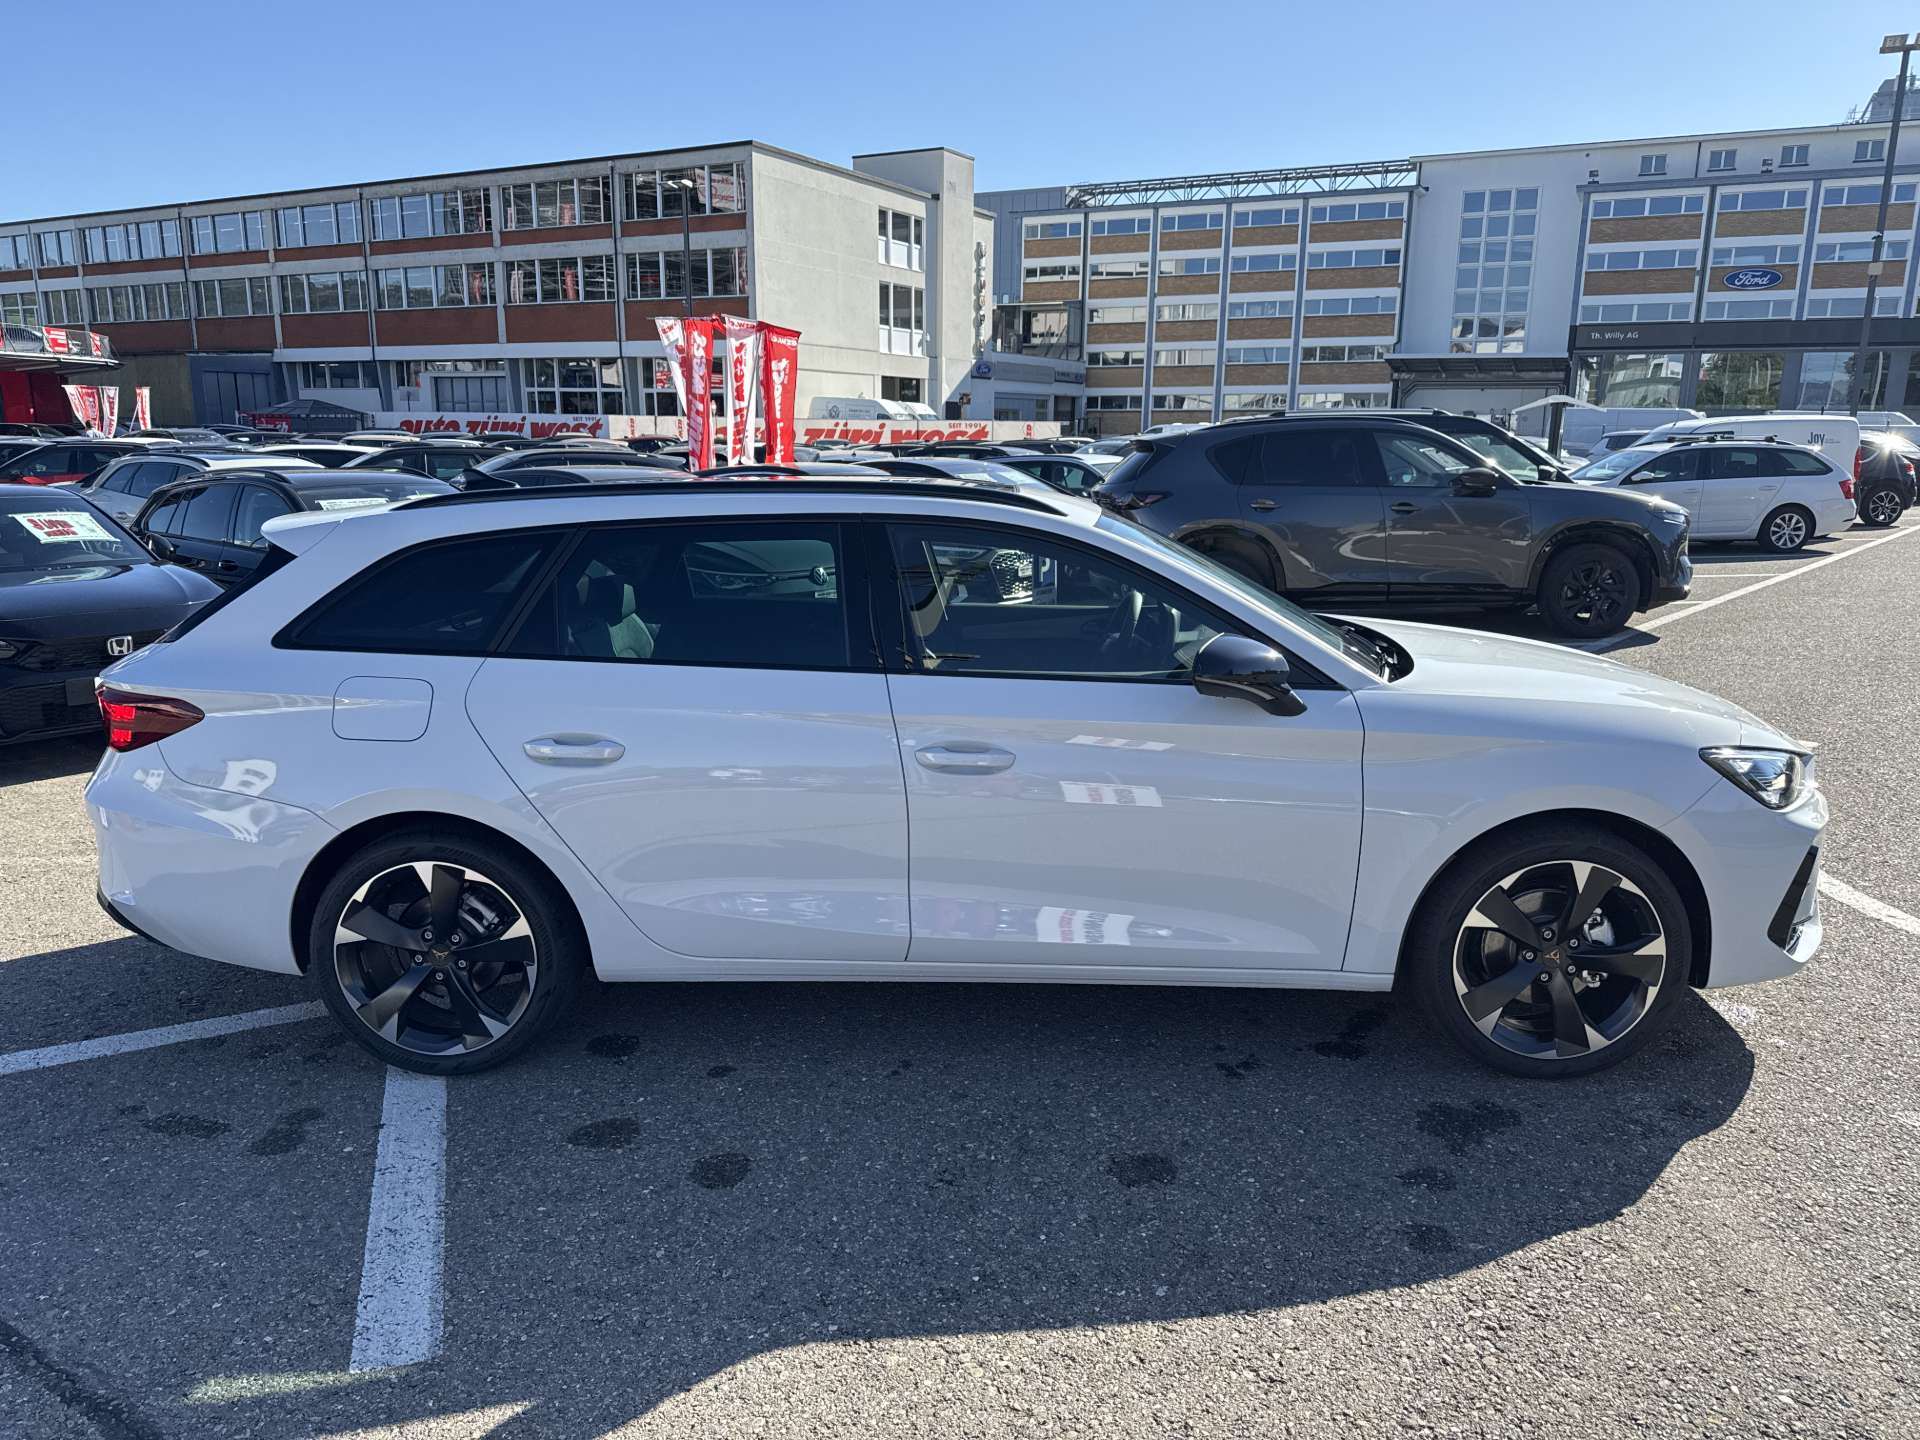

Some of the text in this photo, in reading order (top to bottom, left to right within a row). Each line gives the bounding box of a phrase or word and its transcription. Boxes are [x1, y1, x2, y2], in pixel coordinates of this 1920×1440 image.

[1734, 271, 1771, 286] Ford
[1591, 331, 1639, 341] Th. Willy AG
[1807, 431, 1825, 447] Joy
